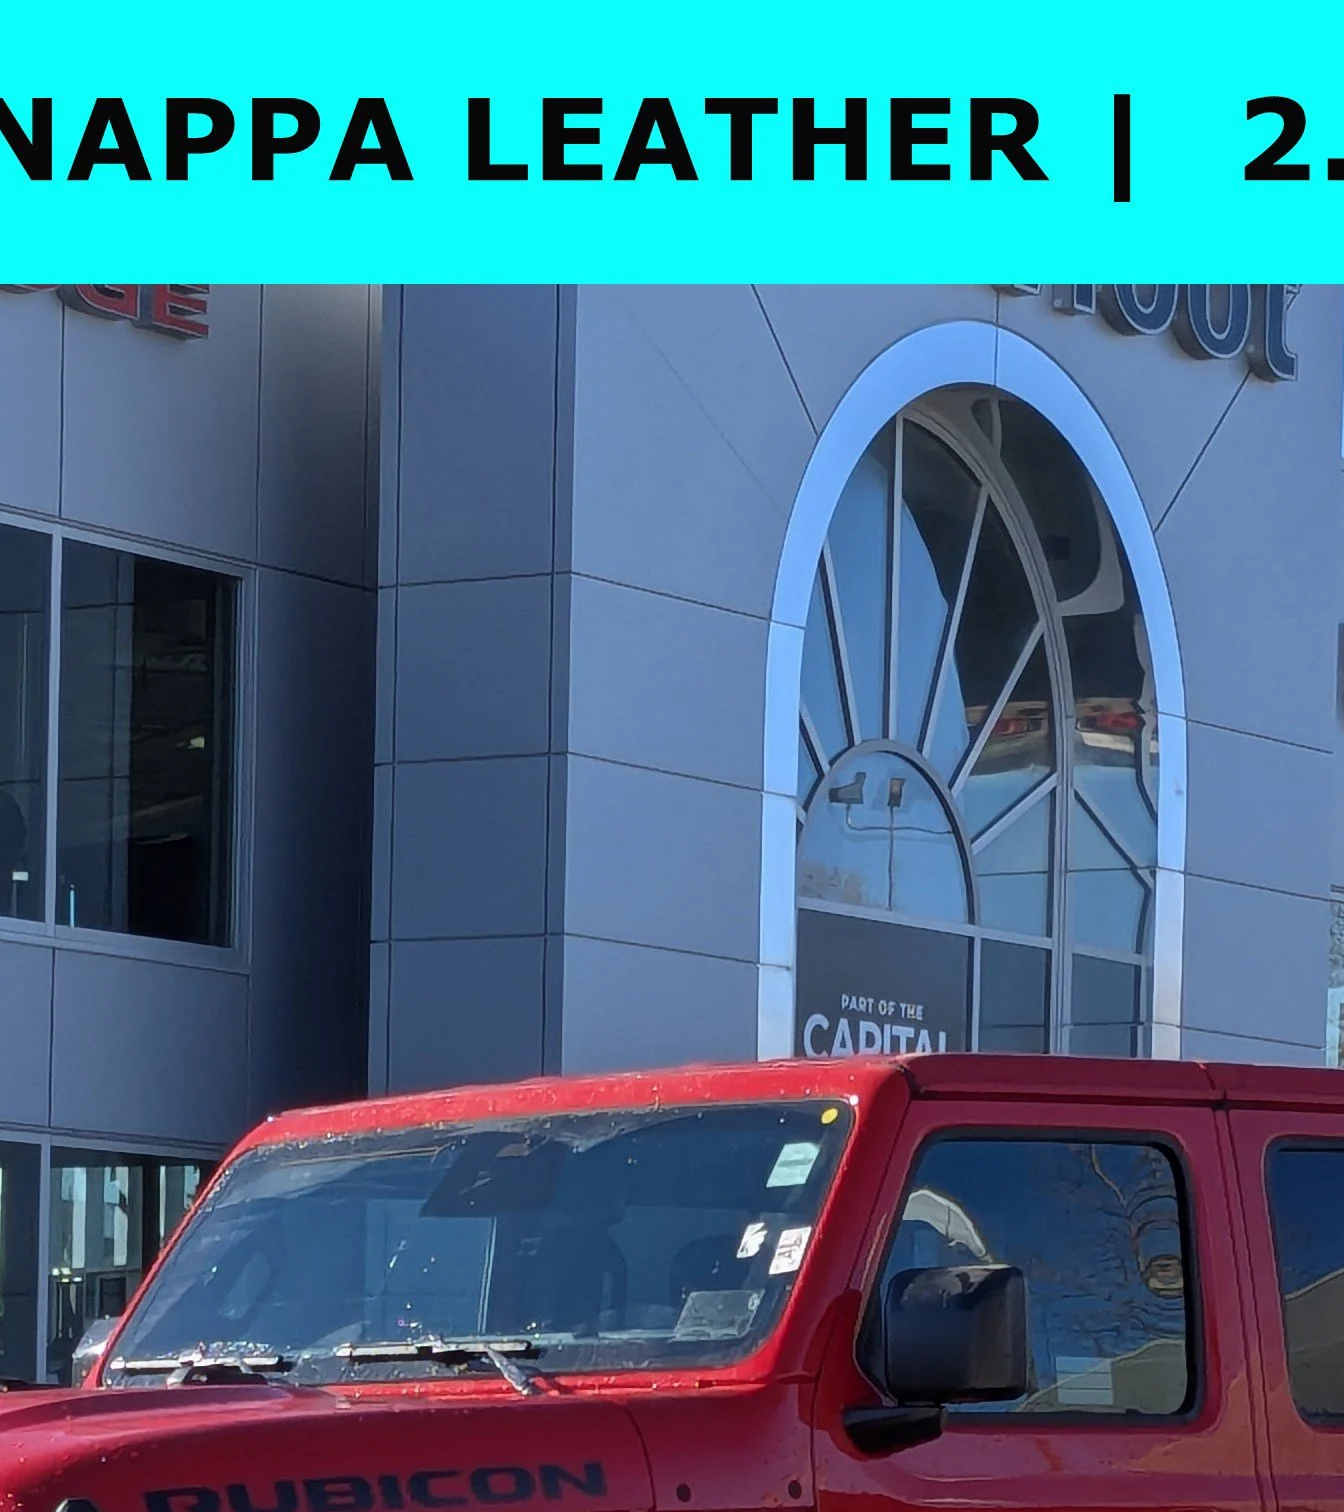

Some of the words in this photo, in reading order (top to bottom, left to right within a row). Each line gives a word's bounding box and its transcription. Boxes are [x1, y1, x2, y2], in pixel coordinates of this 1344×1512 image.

[841, 994, 875, 1014] PART
[878, 1000, 896, 1016] OF
[899, 1002, 924, 1021] THE
